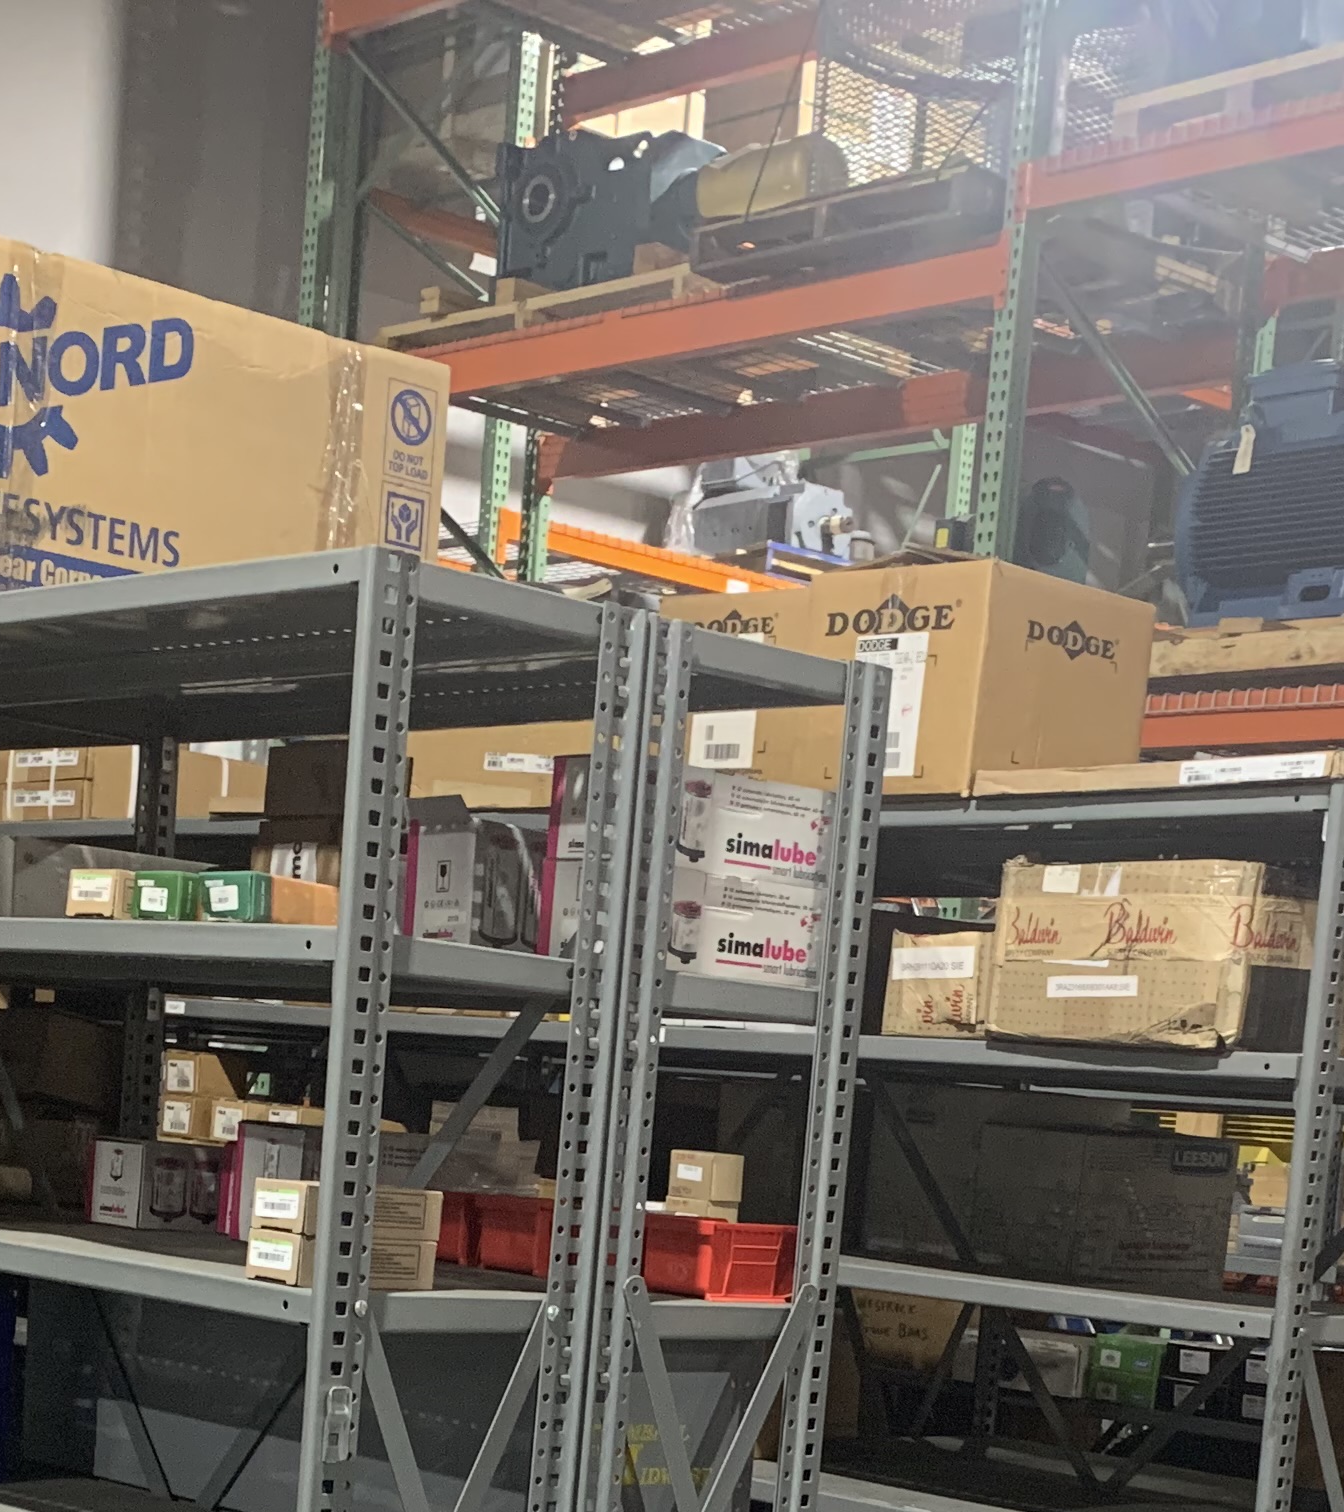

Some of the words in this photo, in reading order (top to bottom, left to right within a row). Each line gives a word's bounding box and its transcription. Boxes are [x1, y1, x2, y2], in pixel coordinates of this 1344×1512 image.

[407, 453, 424, 466] NOT
[825, 602, 956, 637] DODGE
[858, 638, 894, 652] DODGE
[1027, 619, 1116, 661] DODGE
[726, 832, 817, 867] simalube
[717, 932, 807, 963] simalube
[1175, 1151, 1229, 1168] LEESON
